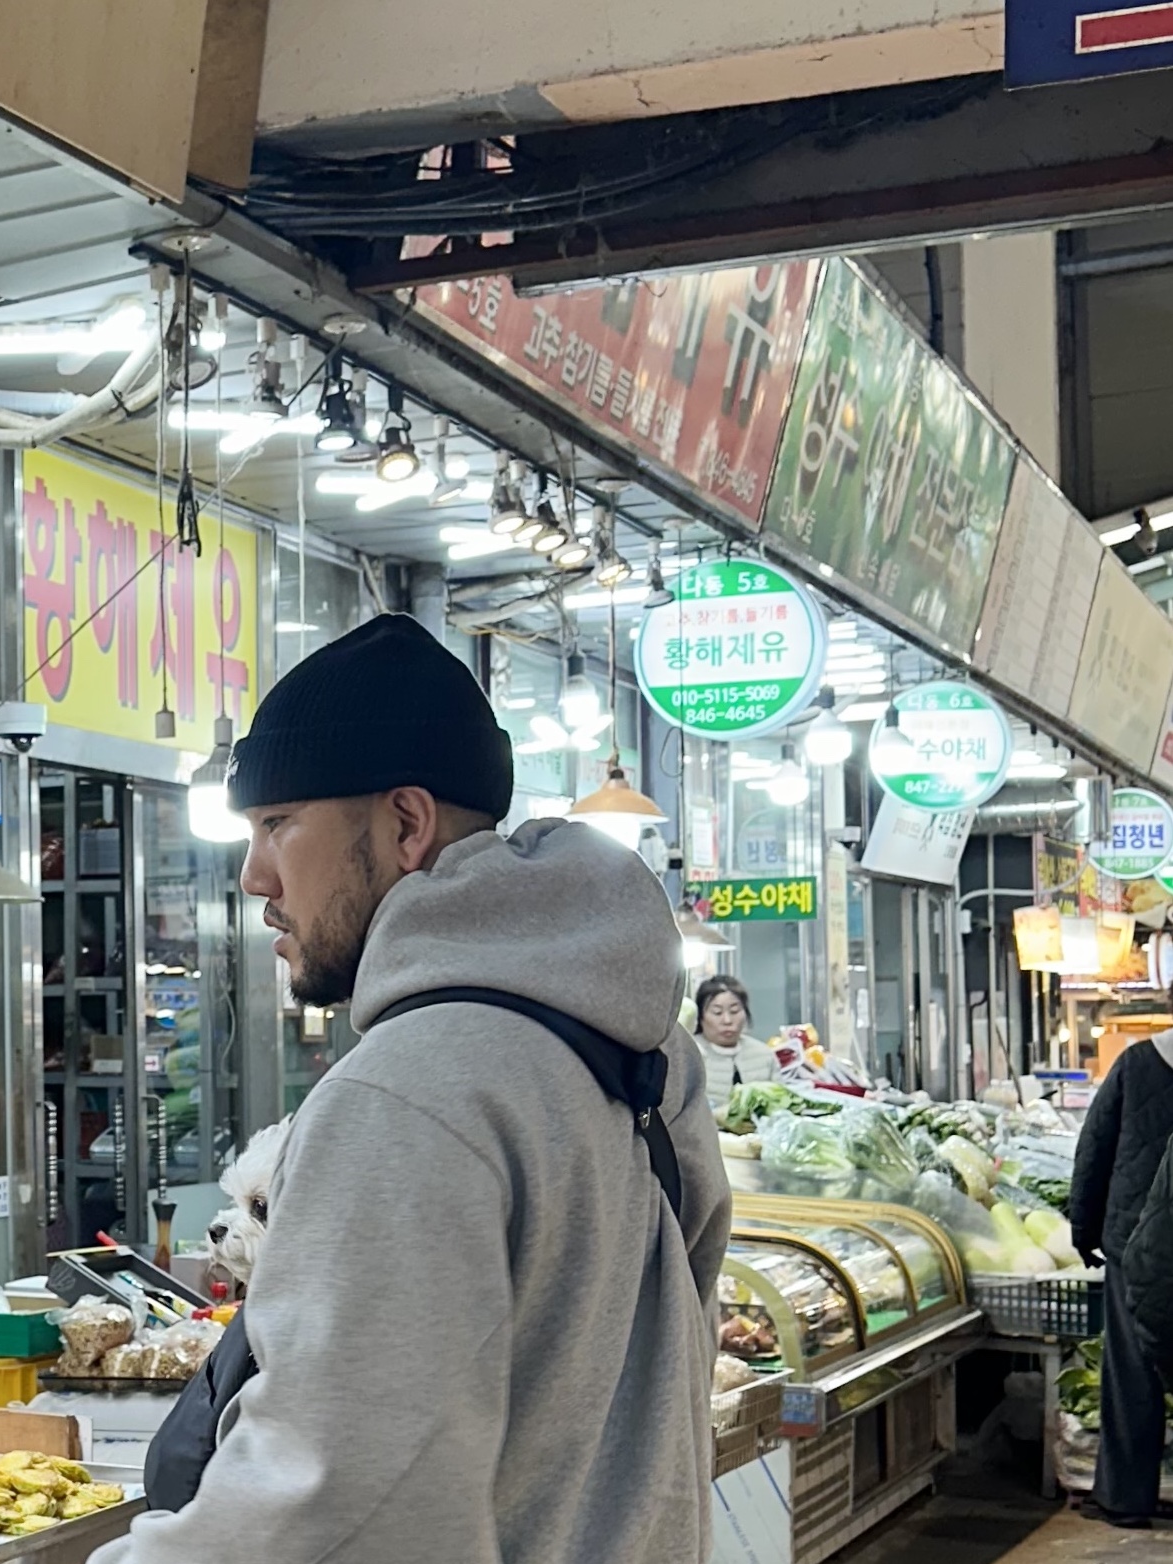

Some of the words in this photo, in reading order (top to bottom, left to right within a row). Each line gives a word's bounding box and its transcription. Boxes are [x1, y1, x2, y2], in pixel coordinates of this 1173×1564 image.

[681, 574, 724, 598] 다동
[737, 572, 770, 592] 5호
[23, 475, 249, 735] 황해제유
[663, 630, 789, 671] 황해제유
[671, 684, 781, 707] 010-5115-5069
[685, 704, 767, 725] 846-4645
[910, 737, 986, 761] 수야채
[710, 880, 813, 918] 성수야채
